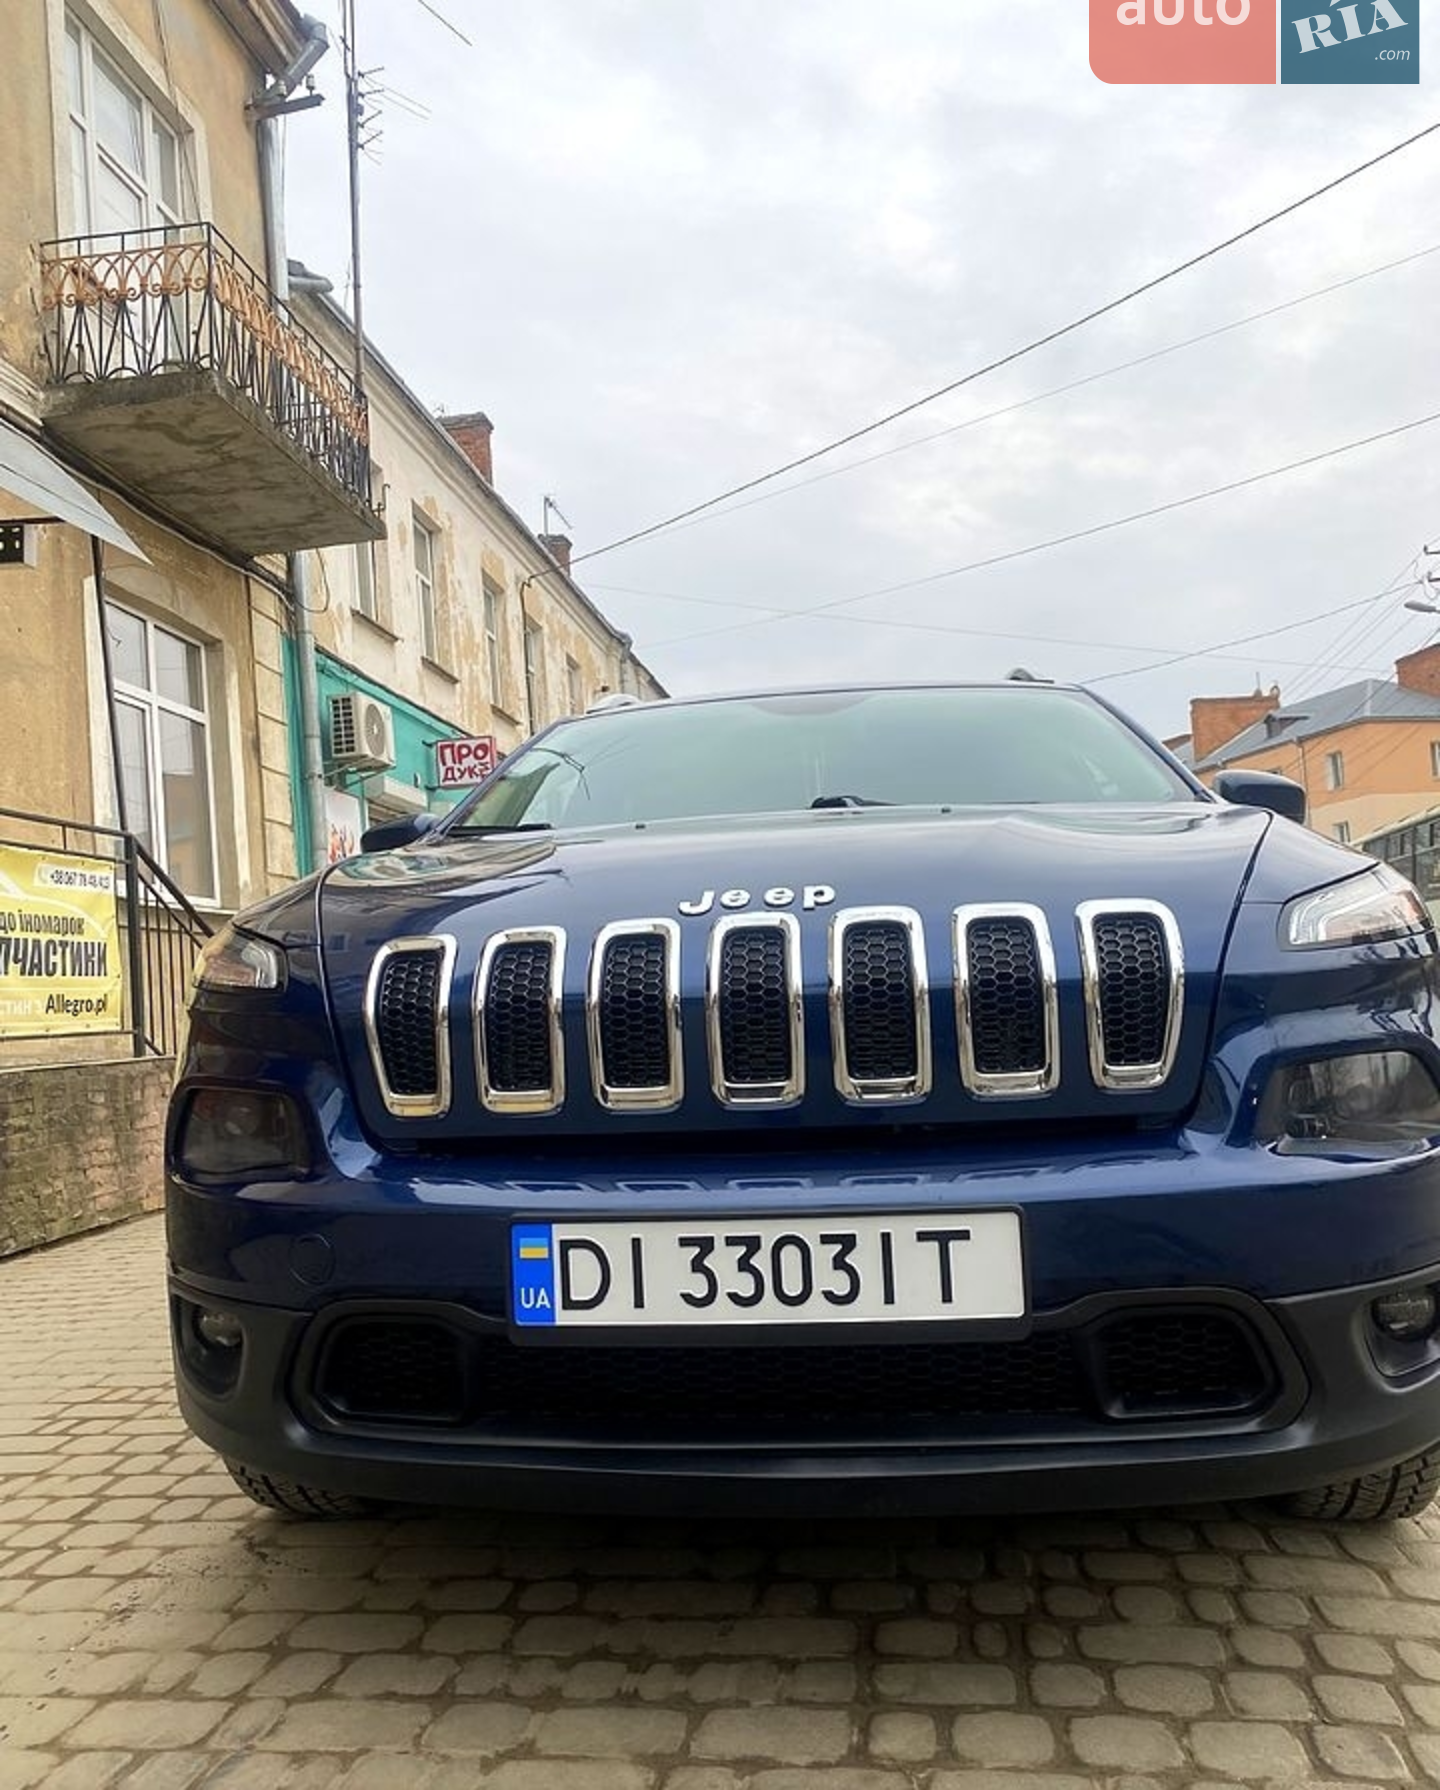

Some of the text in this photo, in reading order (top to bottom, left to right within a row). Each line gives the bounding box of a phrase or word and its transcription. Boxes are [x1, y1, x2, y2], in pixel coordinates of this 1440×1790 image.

[440, 743, 489, 766] ПРО
[678, 884, 836, 916] Jeep
[18, 909, 85, 937] іномарок
[45, 993, 108, 1017] Allegro.pl
[520, 1288, 550, 1310] UA
